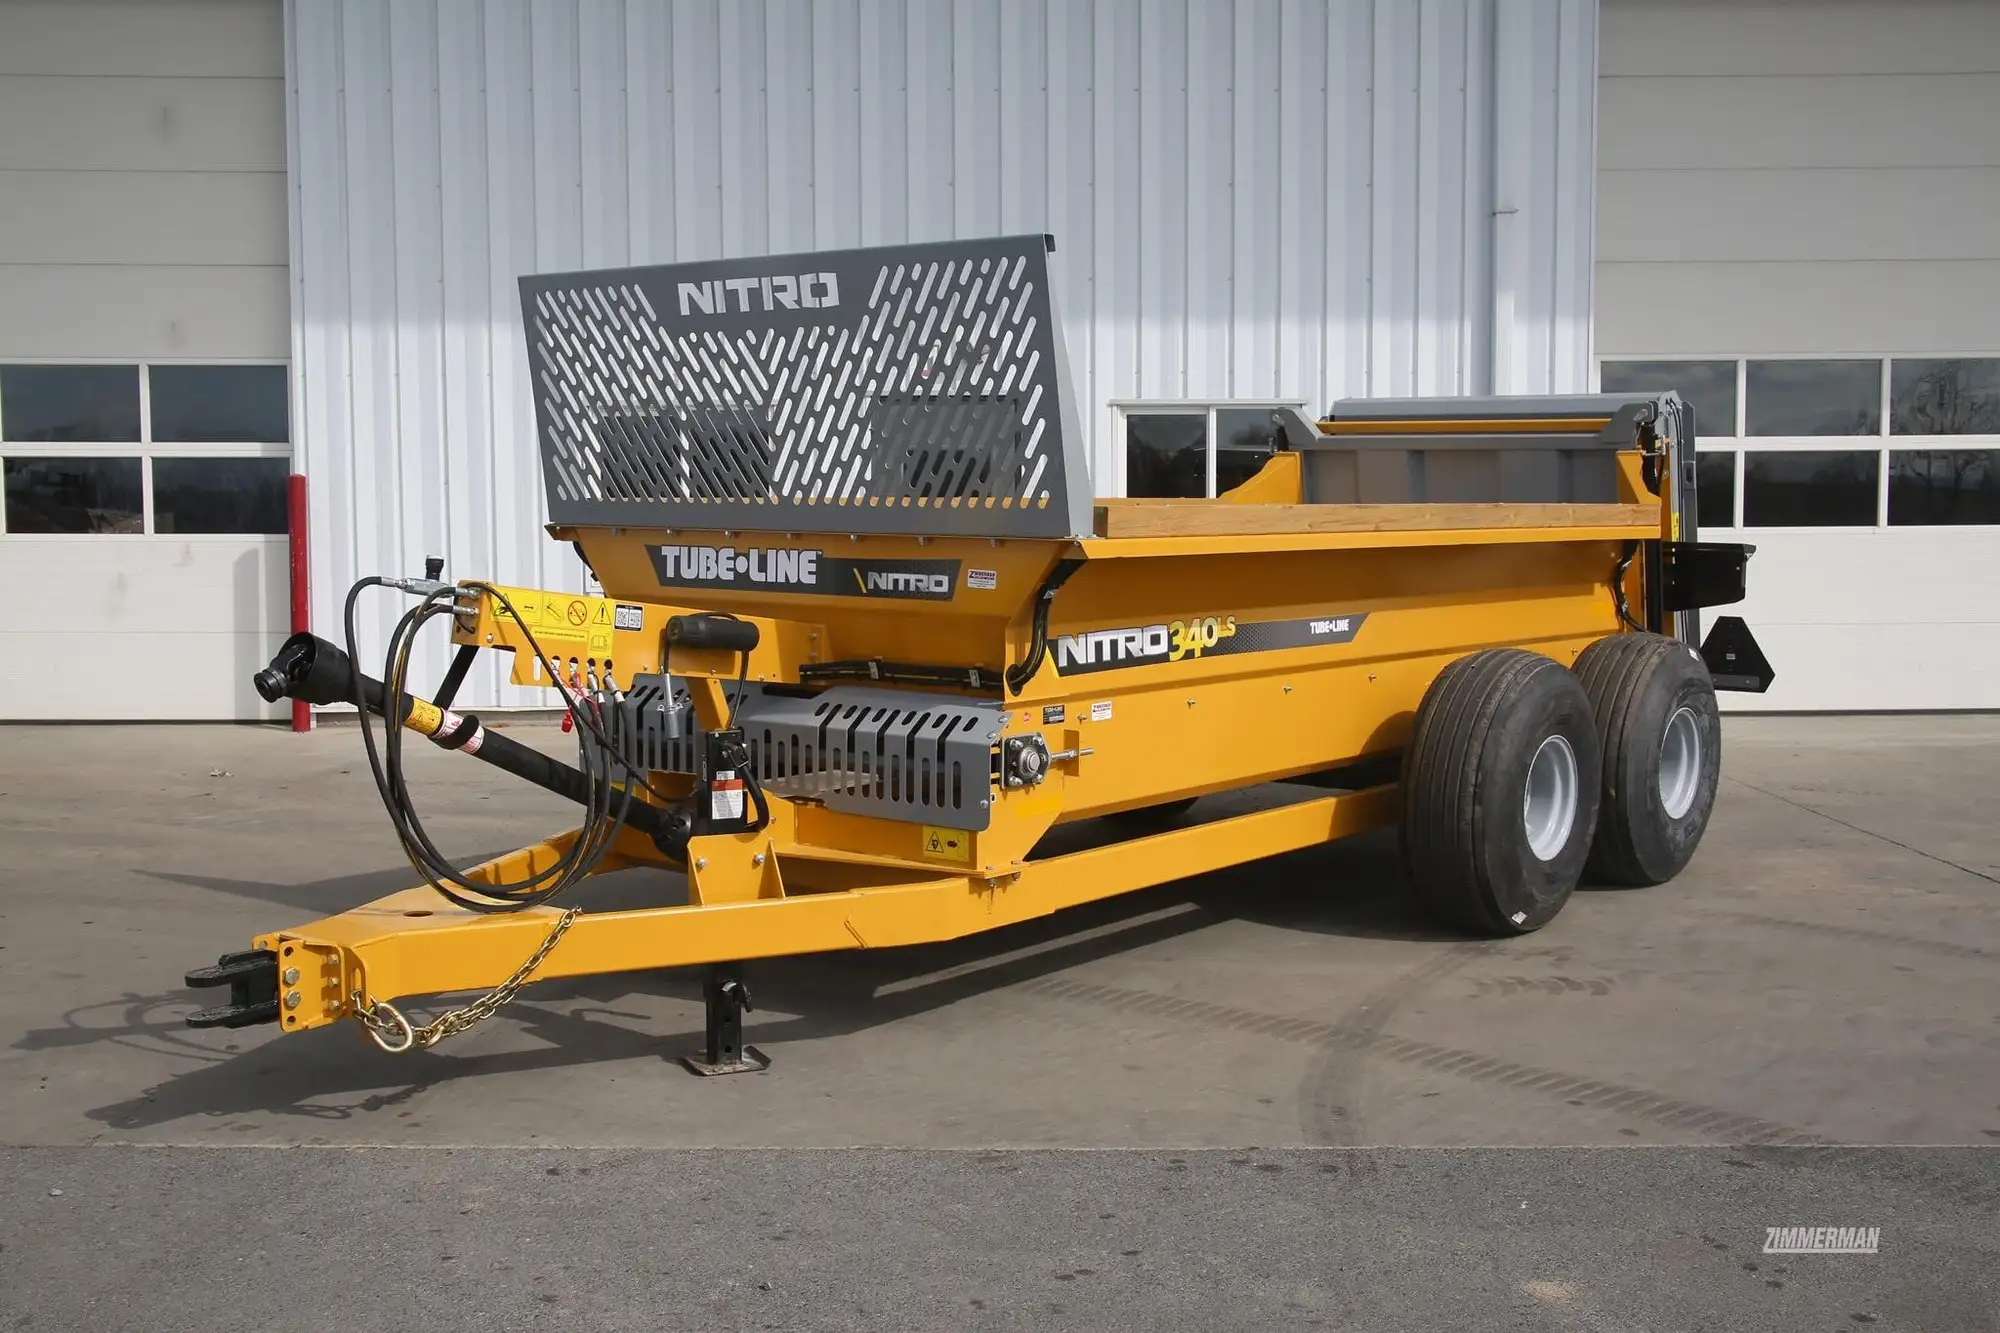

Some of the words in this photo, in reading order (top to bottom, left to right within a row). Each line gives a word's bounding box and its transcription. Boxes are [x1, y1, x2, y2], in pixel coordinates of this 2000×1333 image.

[677, 272, 840, 316] NITRO
[868, 571, 949, 593] NITRO
[1058, 624, 1169, 668] NITRO
